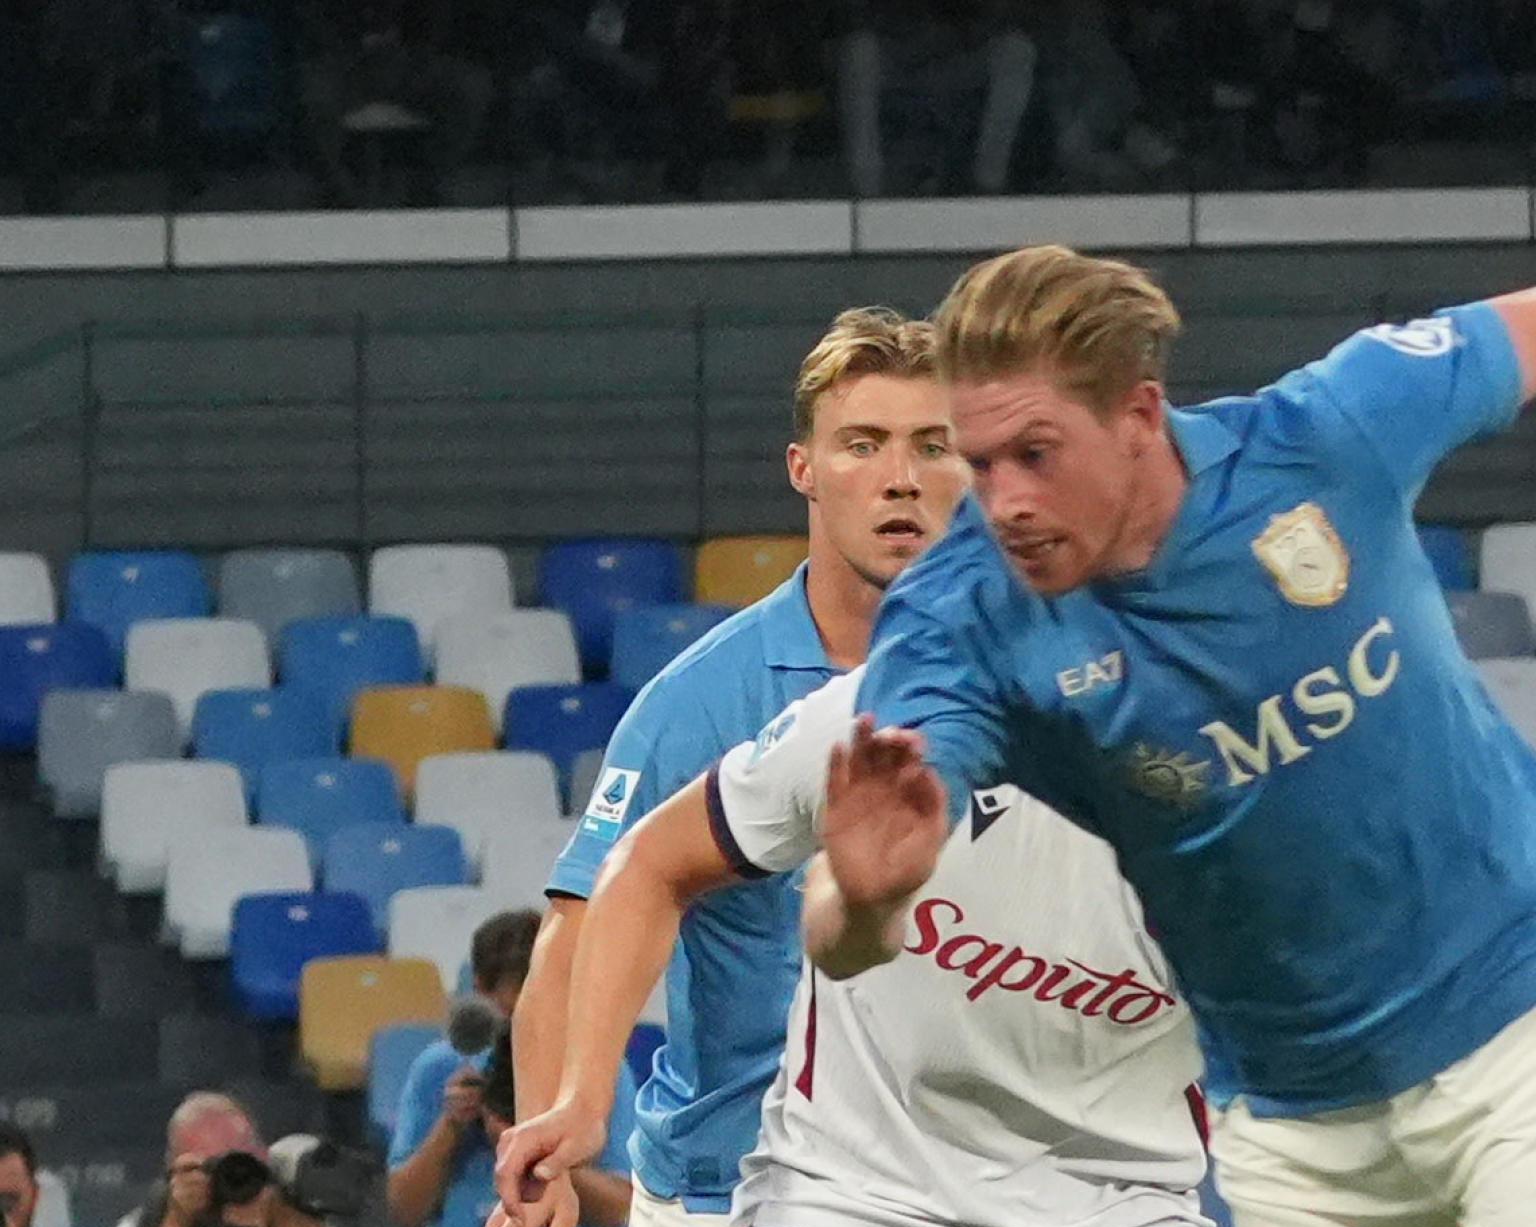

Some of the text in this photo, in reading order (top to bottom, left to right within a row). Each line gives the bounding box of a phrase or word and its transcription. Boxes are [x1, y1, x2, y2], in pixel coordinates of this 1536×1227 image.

[1056, 650, 1124, 697] EA7
[1199, 617, 1400, 786] MSC
[904, 898, 1176, 1025] Saputo
